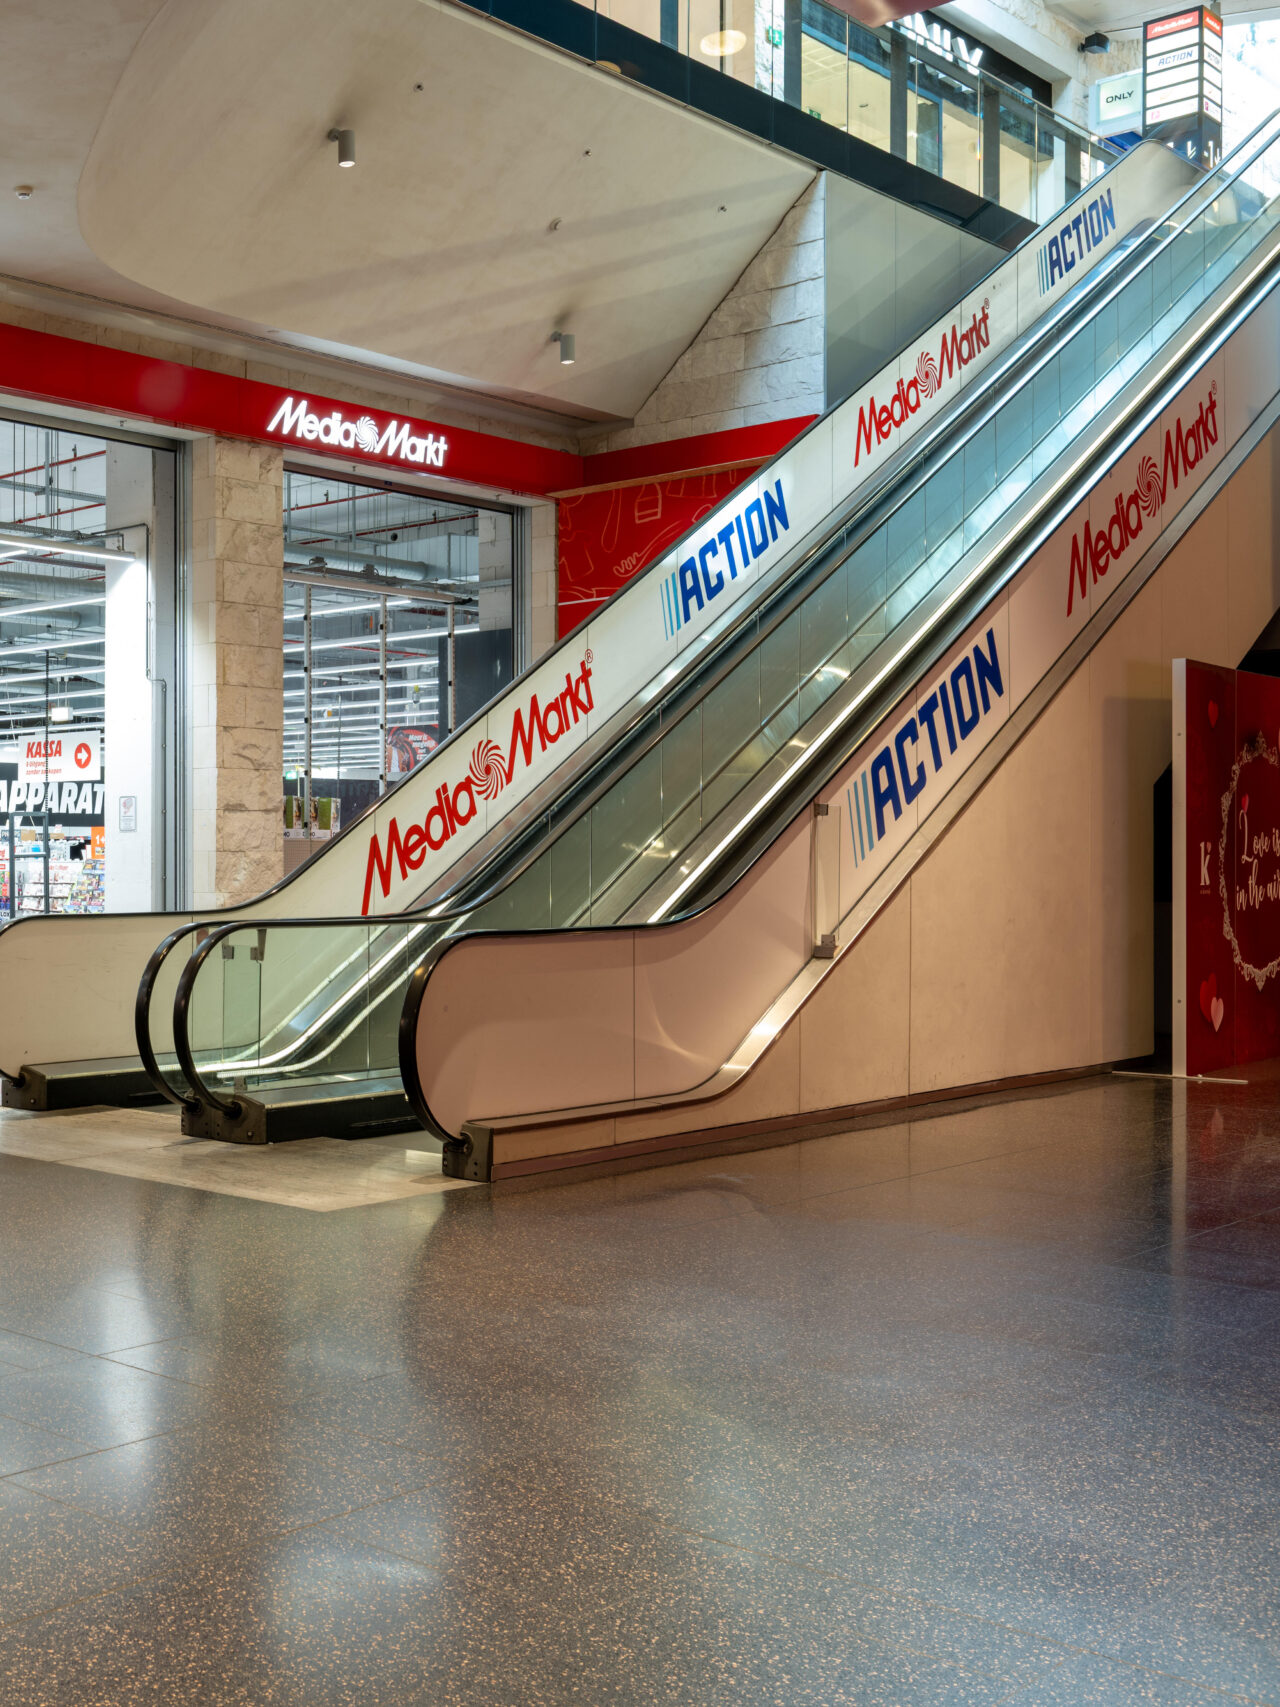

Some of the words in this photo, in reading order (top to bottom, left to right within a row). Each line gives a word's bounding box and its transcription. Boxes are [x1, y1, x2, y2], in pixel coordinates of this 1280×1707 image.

[1106, 90, 1134, 104] ONLY
[1158, 50, 1193, 66] ACTION
[1048, 187, 1116, 288] ACTION
[266, 397, 357, 449] Media
[374, 420, 448, 467] Markt
[854, 375, 922, 468] Media
[679, 478, 790, 624] ACTION
[1067, 489, 1143, 617] Media
[26, 739, 62, 759] KASSA
[870, 627, 1005, 841] ACTION
[361, 775, 478, 916] Media
[1239, 809, 1271, 864] Love
[1236, 885, 1247, 911] in
[1248, 859, 1265, 910] the
